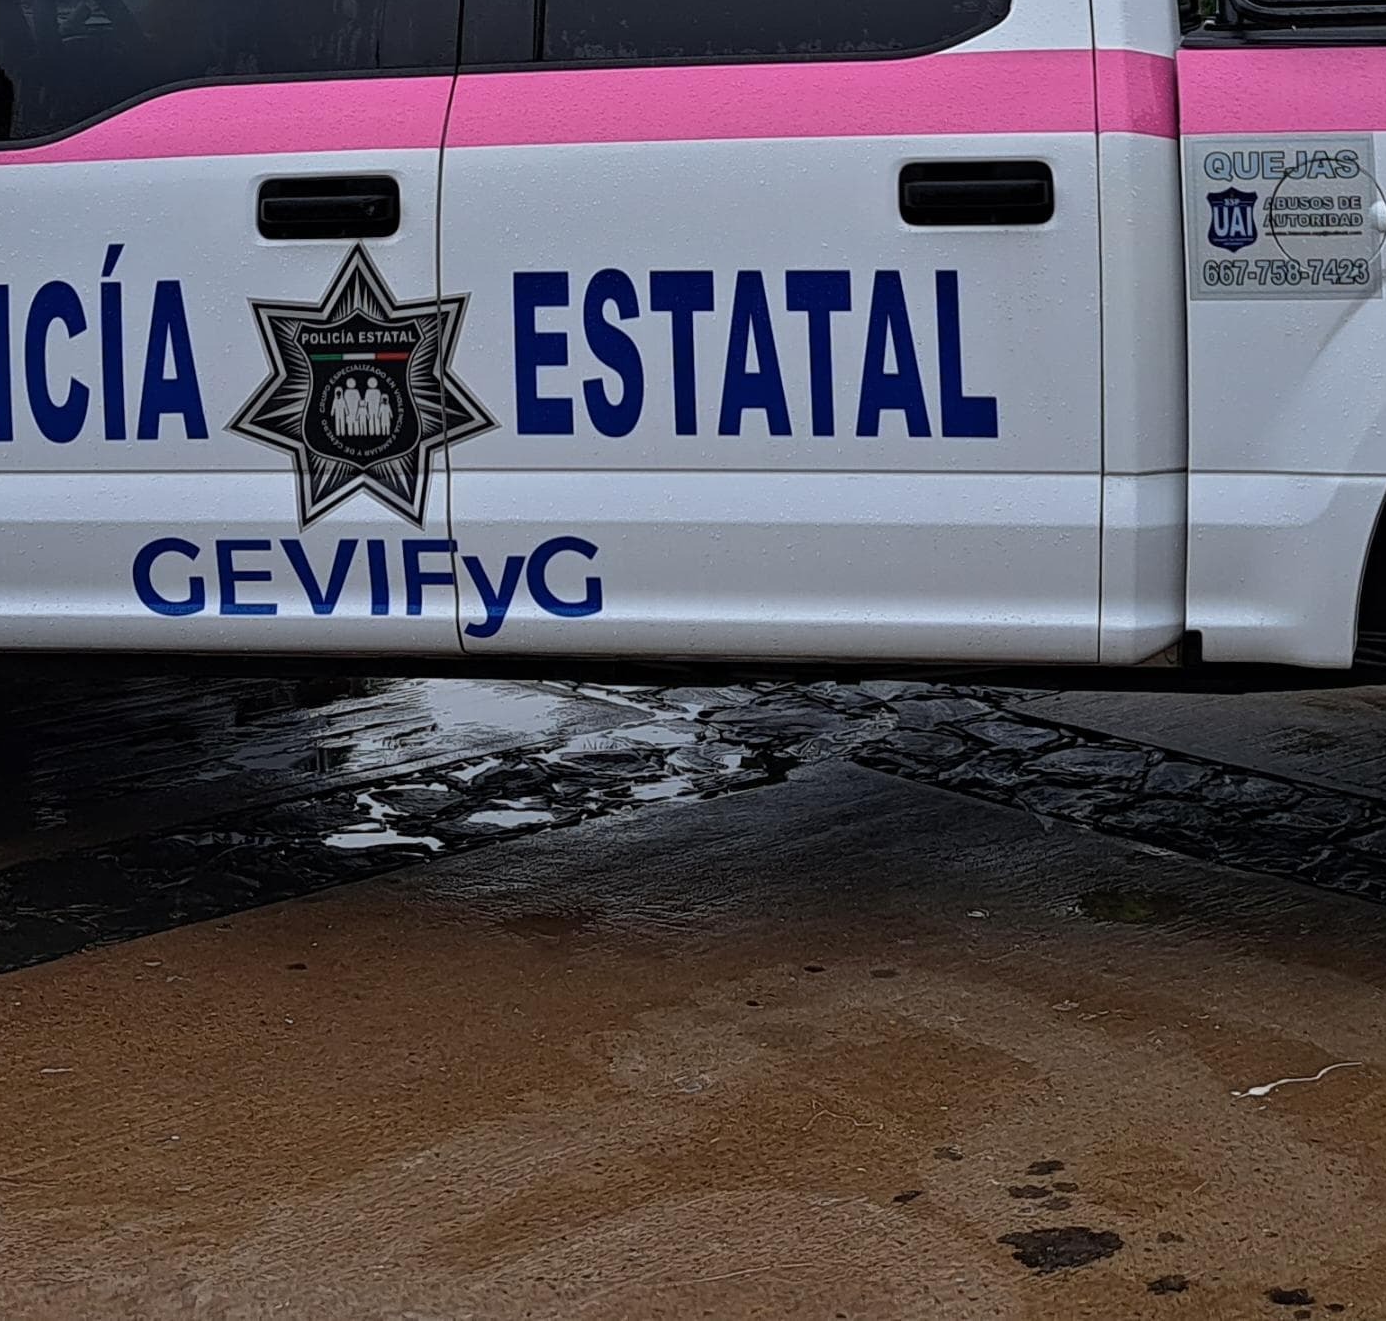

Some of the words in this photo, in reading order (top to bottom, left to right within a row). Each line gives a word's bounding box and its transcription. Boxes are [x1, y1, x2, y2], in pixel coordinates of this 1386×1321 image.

[1203, 149, 1360, 182] QUEJAS
[1262, 196, 1335, 211] ABUSOS
[1337, 194, 1362, 210] DE
[1213, 206, 1253, 237] UAI
[1262, 212, 1364, 228] AUTORIDAD
[1203, 258, 1370, 286] 667-758-7423
[301, 328, 355, 345] POLICÍA
[358, 330, 417, 344] ESTATAL
[512, 268, 999, 439] ESTATAL
[131, 535, 603, 639] GEVIFyG
